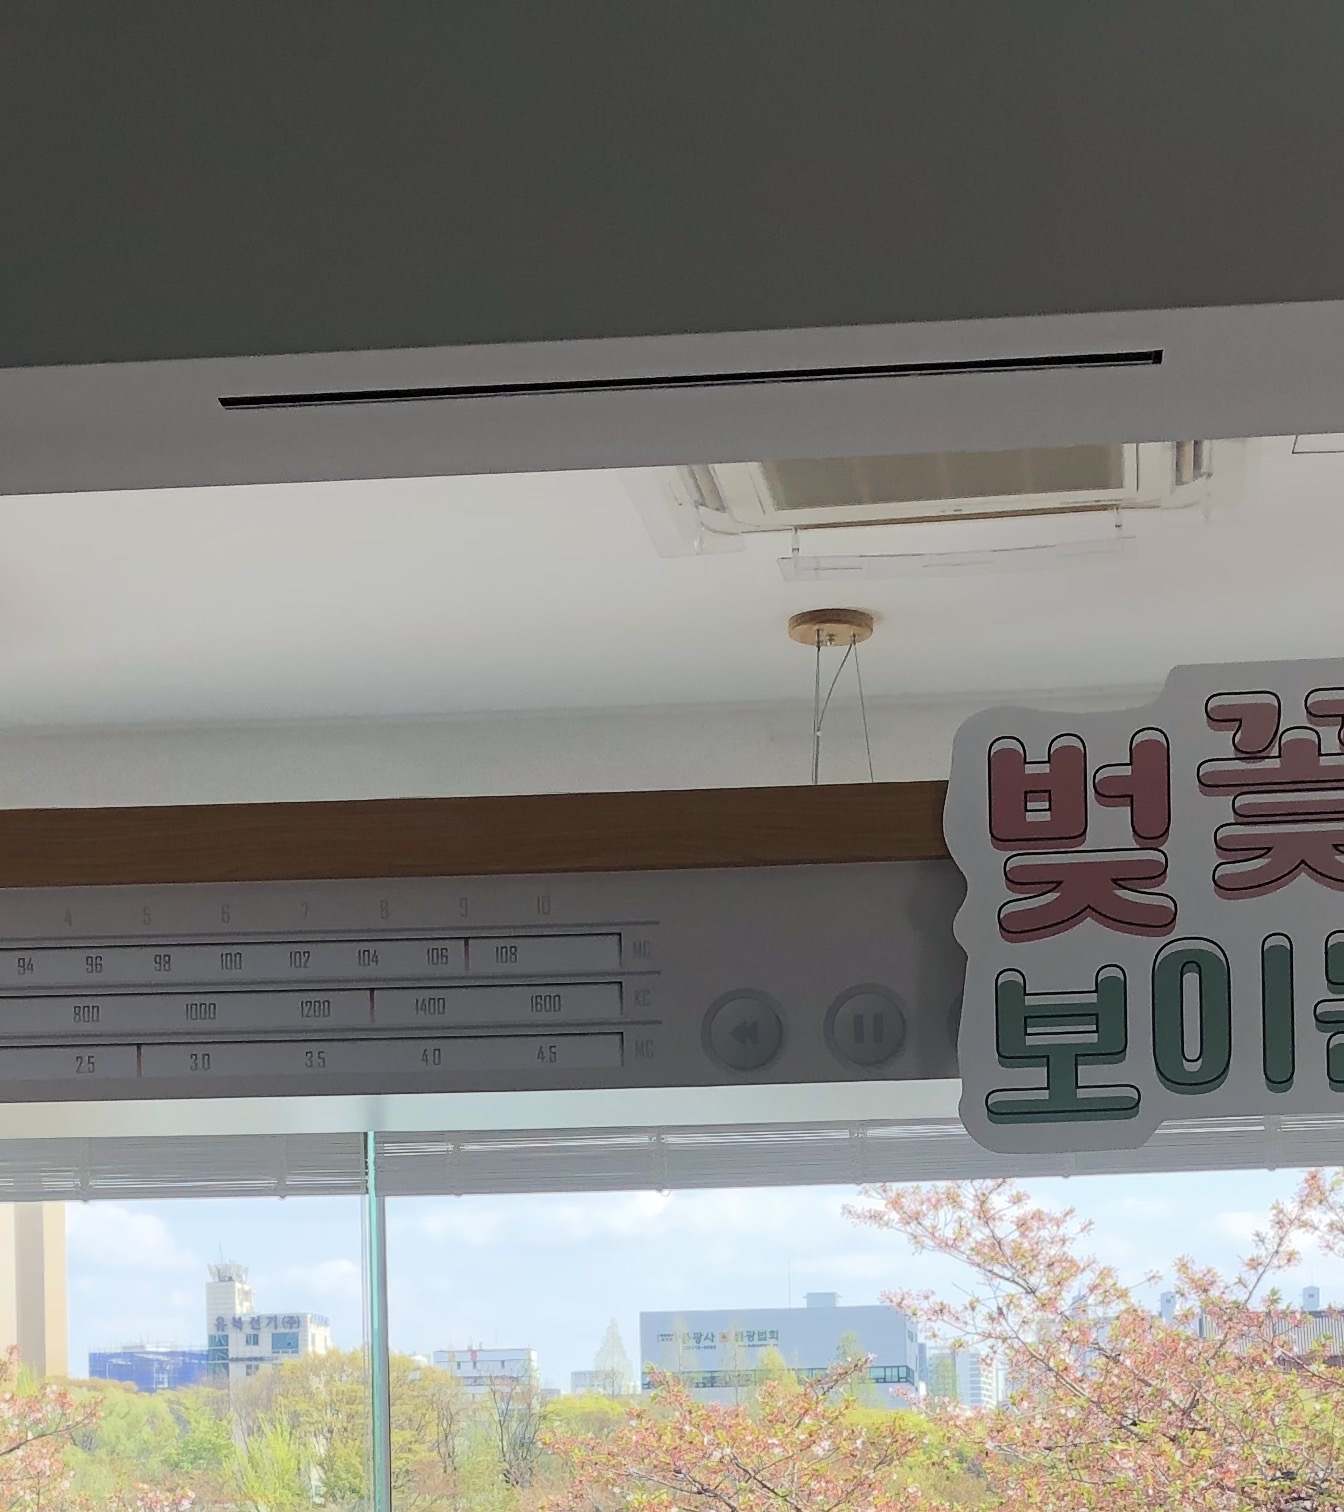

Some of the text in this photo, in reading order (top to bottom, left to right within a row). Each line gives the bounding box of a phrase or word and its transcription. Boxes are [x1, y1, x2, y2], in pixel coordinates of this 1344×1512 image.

[17, 957, 34, 974] 94
[85, 955, 103, 974] 96
[153, 953, 172, 972] 98
[220, 951, 242, 970] 100
[289, 950, 311, 968] 102
[357, 949, 379, 967] 104
[426, 947, 449, 965] 106
[495, 945, 518, 963] 108
[73, 1005, 100, 1022] 800
[185, 1002, 217, 1021] 1000
[300, 999, 331, 1018] 1200
[415, 997, 446, 1015] 1400
[530, 994, 562, 1012] 1600
